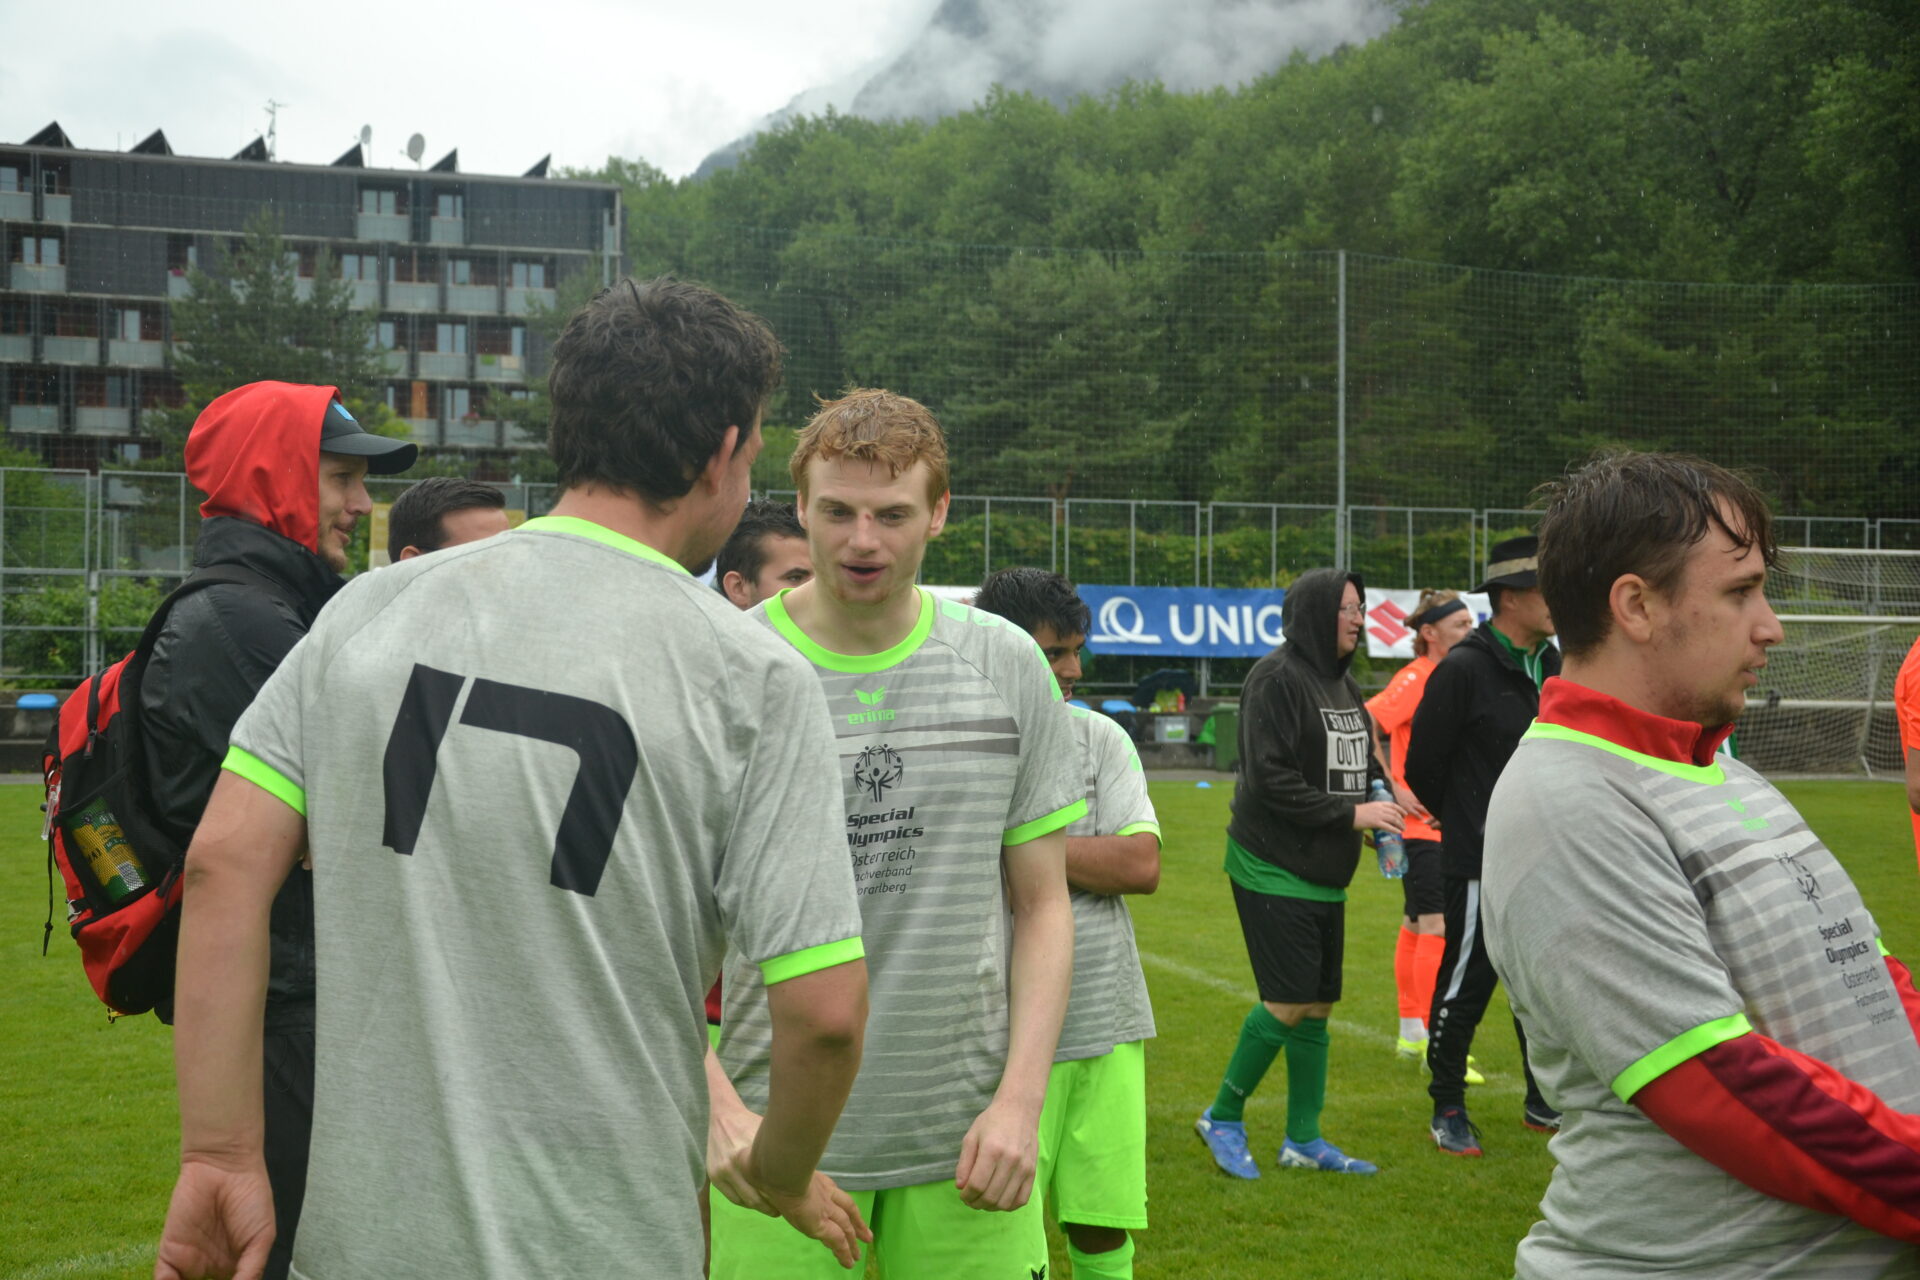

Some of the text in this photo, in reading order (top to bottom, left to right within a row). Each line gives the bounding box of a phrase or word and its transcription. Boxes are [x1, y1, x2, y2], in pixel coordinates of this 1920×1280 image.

[1168, 604, 1287, 647] UNIQ
[848, 709, 896, 725] erima
[1328, 711, 1366, 733] STRAIGH
[1336, 736, 1367, 766] OUTT
[1343, 772, 1356, 791] MY
[847, 806, 915, 829] Special
[854, 865, 912, 882] achverband
[857, 882, 907, 896] orarlberg
[1818, 917, 1853, 943] Special
[1826, 941, 1870, 965] Olympics
